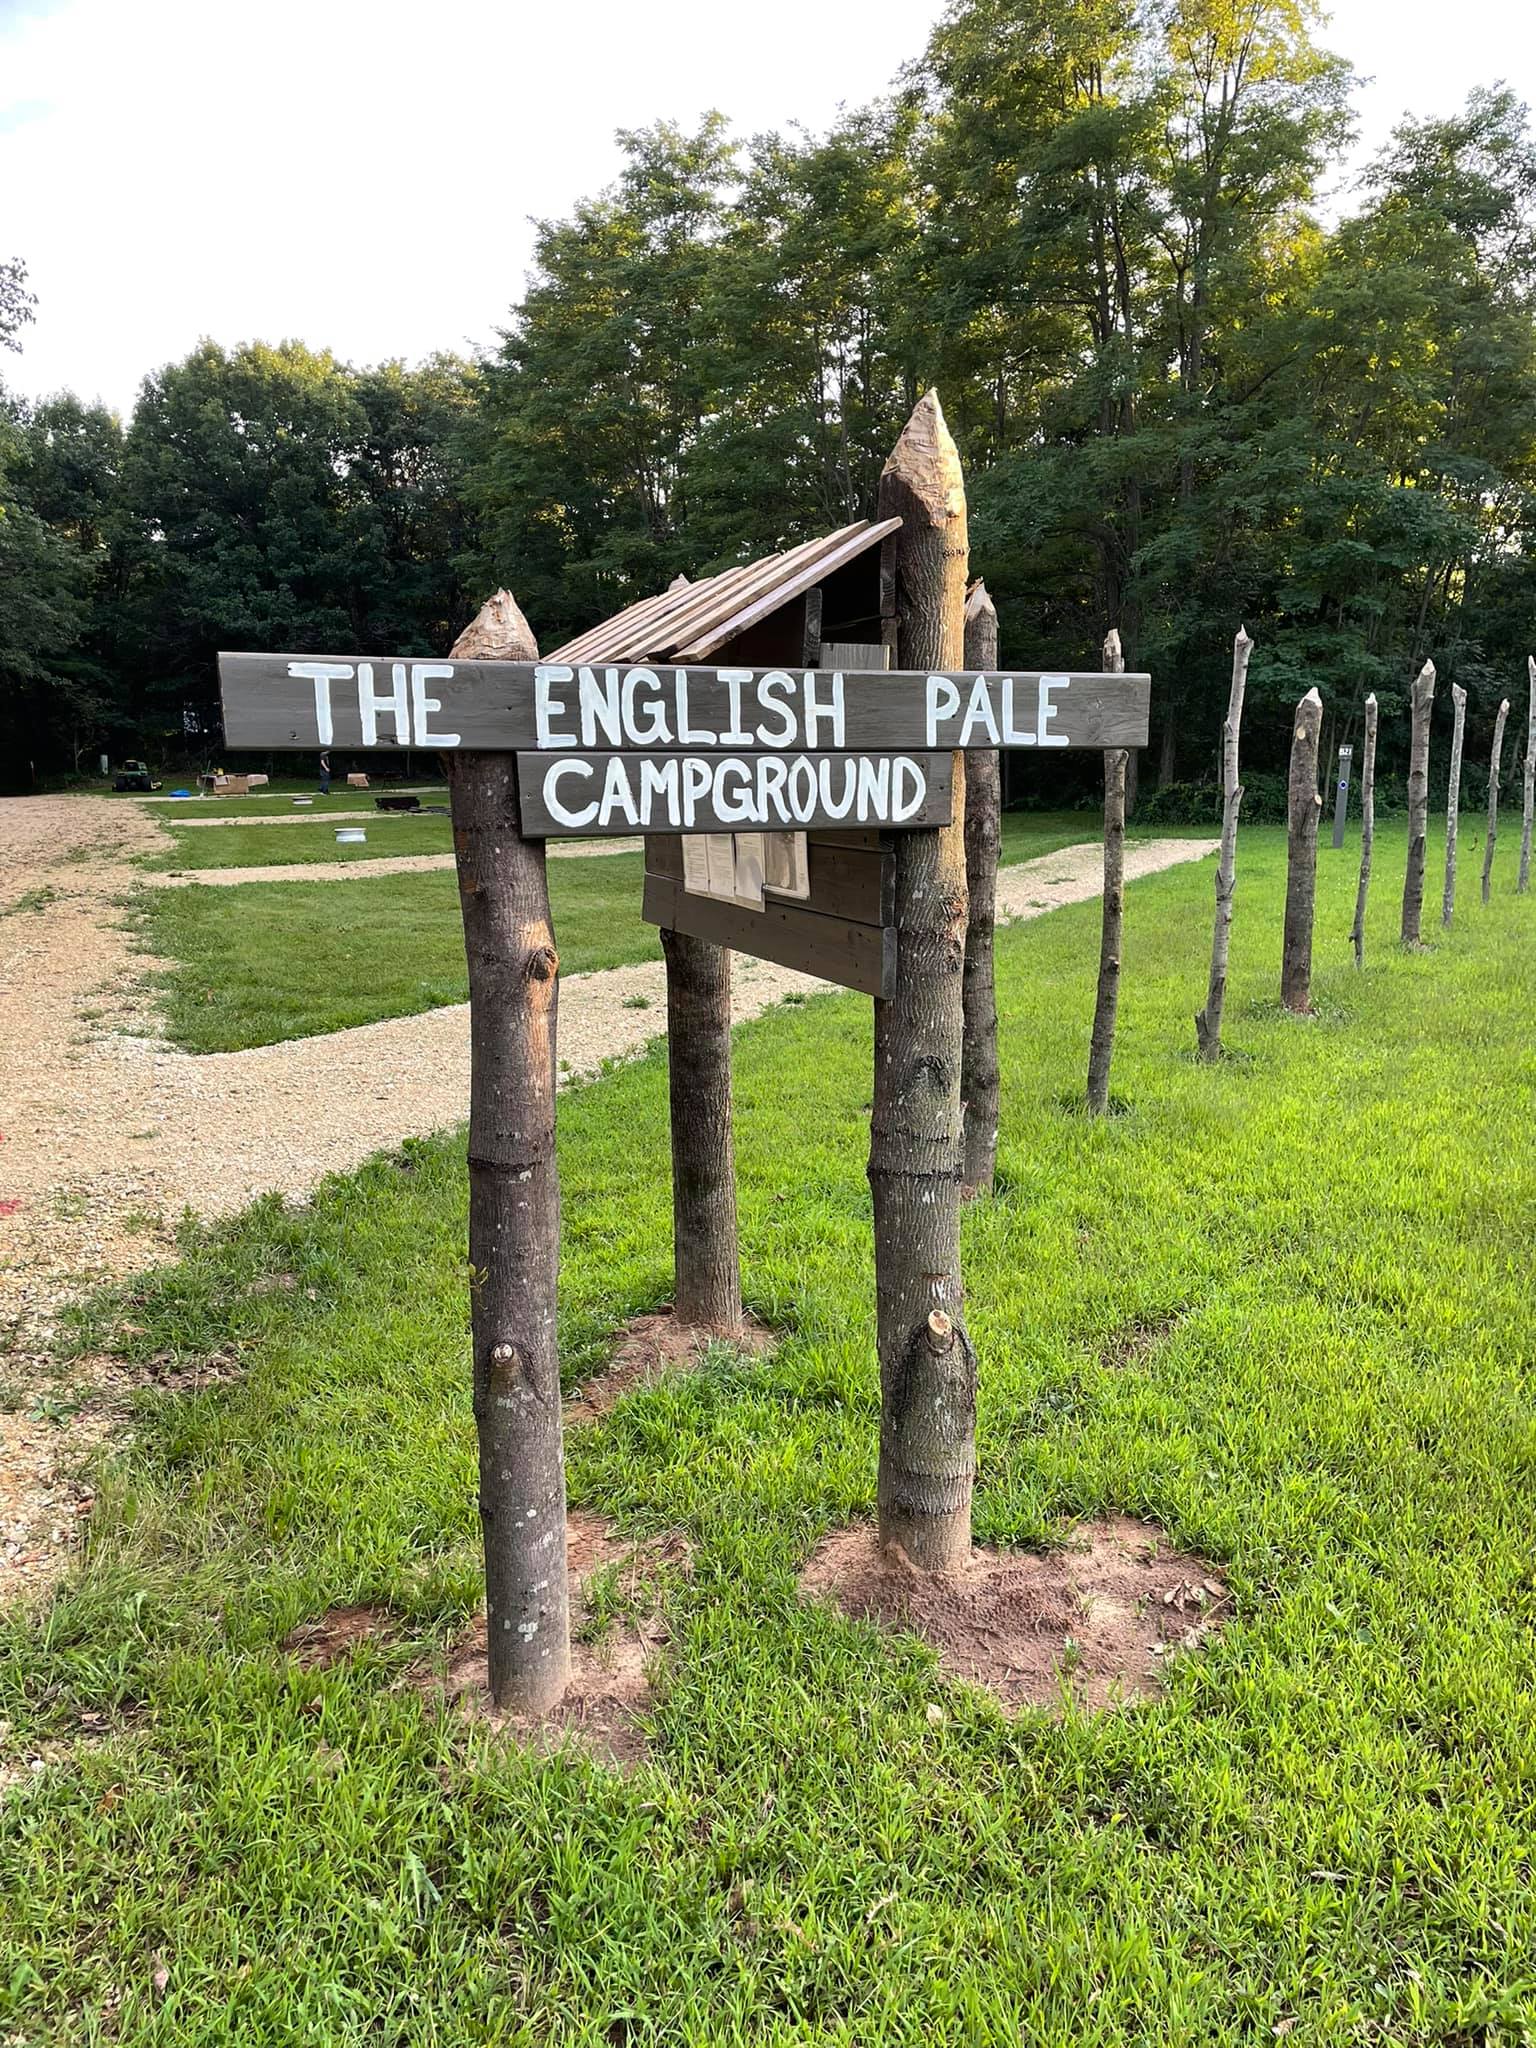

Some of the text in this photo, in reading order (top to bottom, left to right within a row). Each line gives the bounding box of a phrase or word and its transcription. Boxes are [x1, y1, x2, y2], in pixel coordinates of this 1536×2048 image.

[287, 662, 1071, 748] THE ENGLISH PALE
[542, 754, 927, 828] CAMPGROUND
